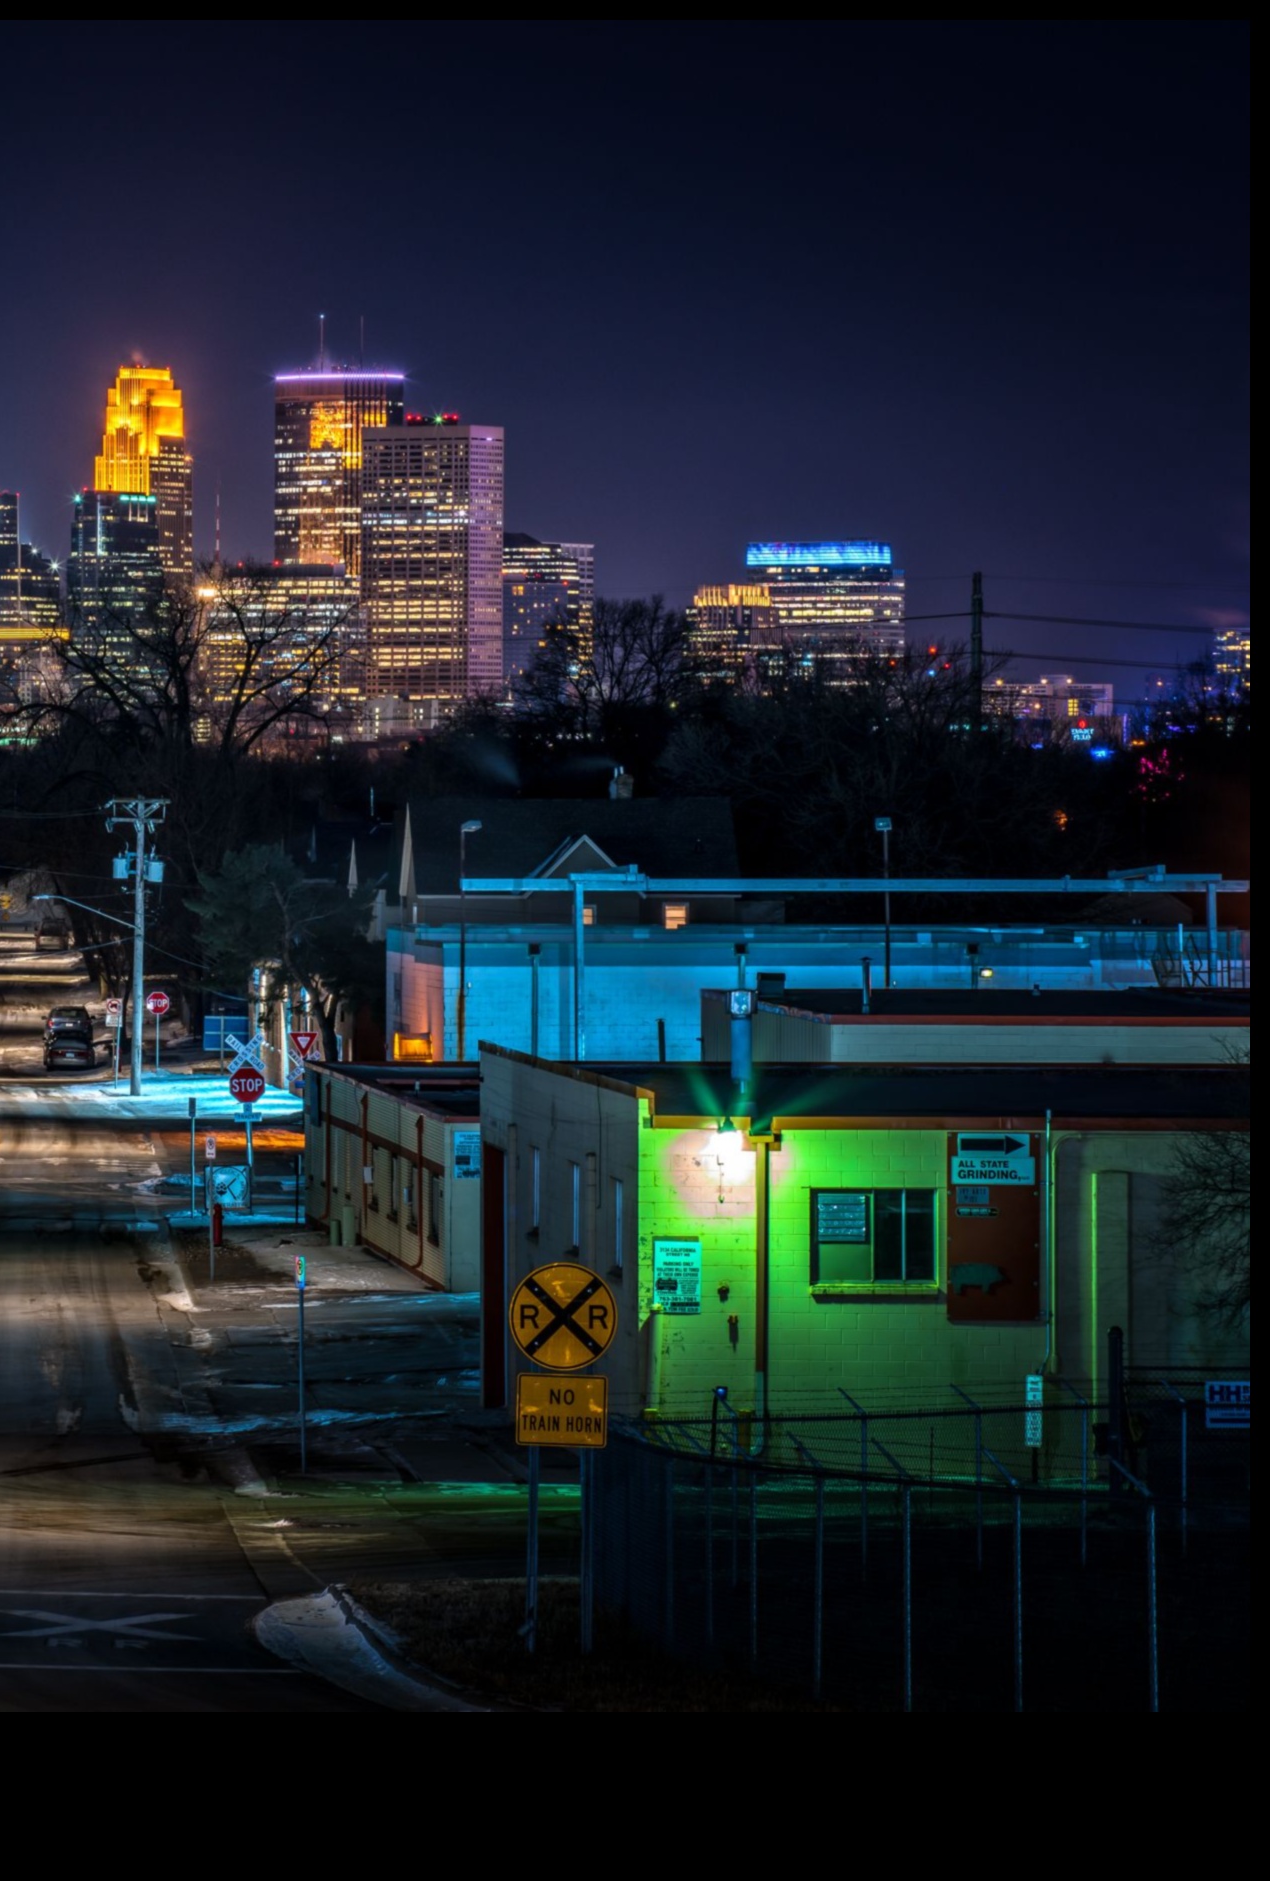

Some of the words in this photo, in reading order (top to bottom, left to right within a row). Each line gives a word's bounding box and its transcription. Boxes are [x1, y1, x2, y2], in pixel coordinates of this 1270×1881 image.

[229, 1033, 264, 1072] CROSSING
[232, 1079, 263, 1093] STOP
[958, 1160, 976, 1168] ALL
[980, 1160, 1009, 1168] STATE
[520, 1304, 539, 1329] R
[588, 1305, 608, 1330] R
[549, 1388, 575, 1405] NO
[521, 1414, 560, 1432] TRAIN
[565, 1415, 601, 1433] HORN
